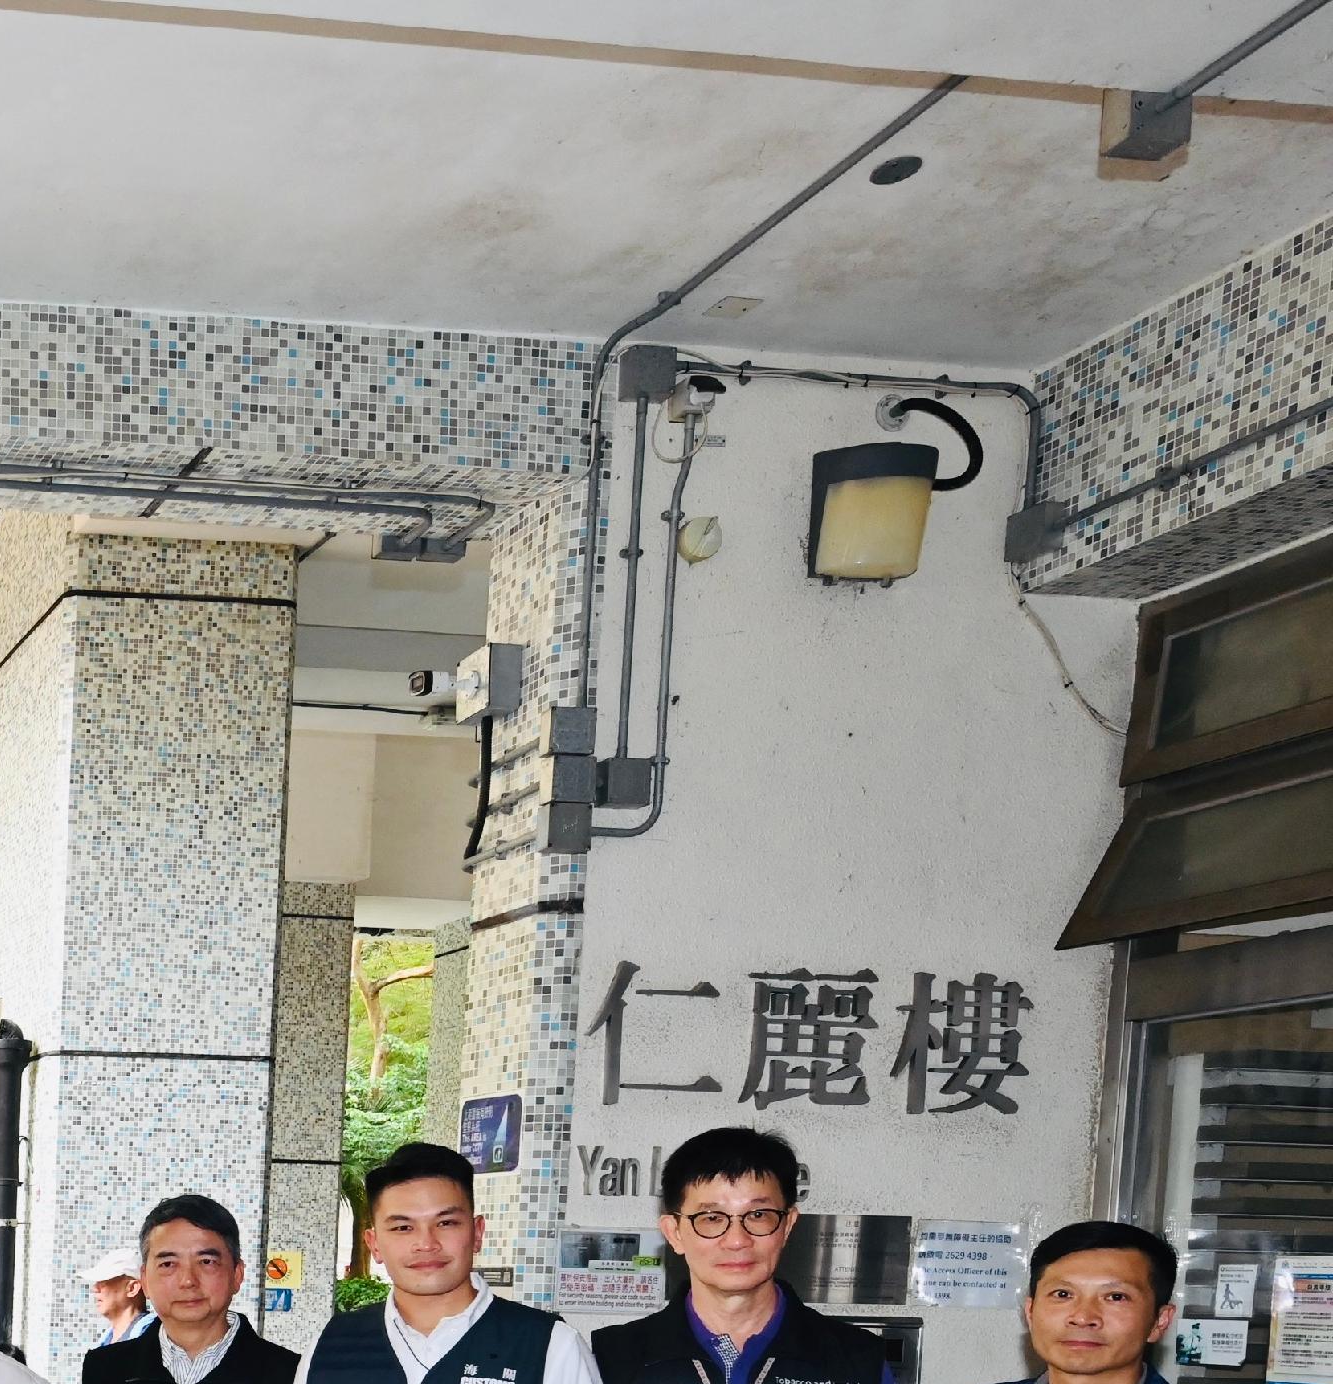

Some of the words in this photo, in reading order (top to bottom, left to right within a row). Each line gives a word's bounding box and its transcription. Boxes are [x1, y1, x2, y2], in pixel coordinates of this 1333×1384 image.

[583, 959, 1034, 1116] 仁麗樓
[577, 1145, 641, 1198] Yan
